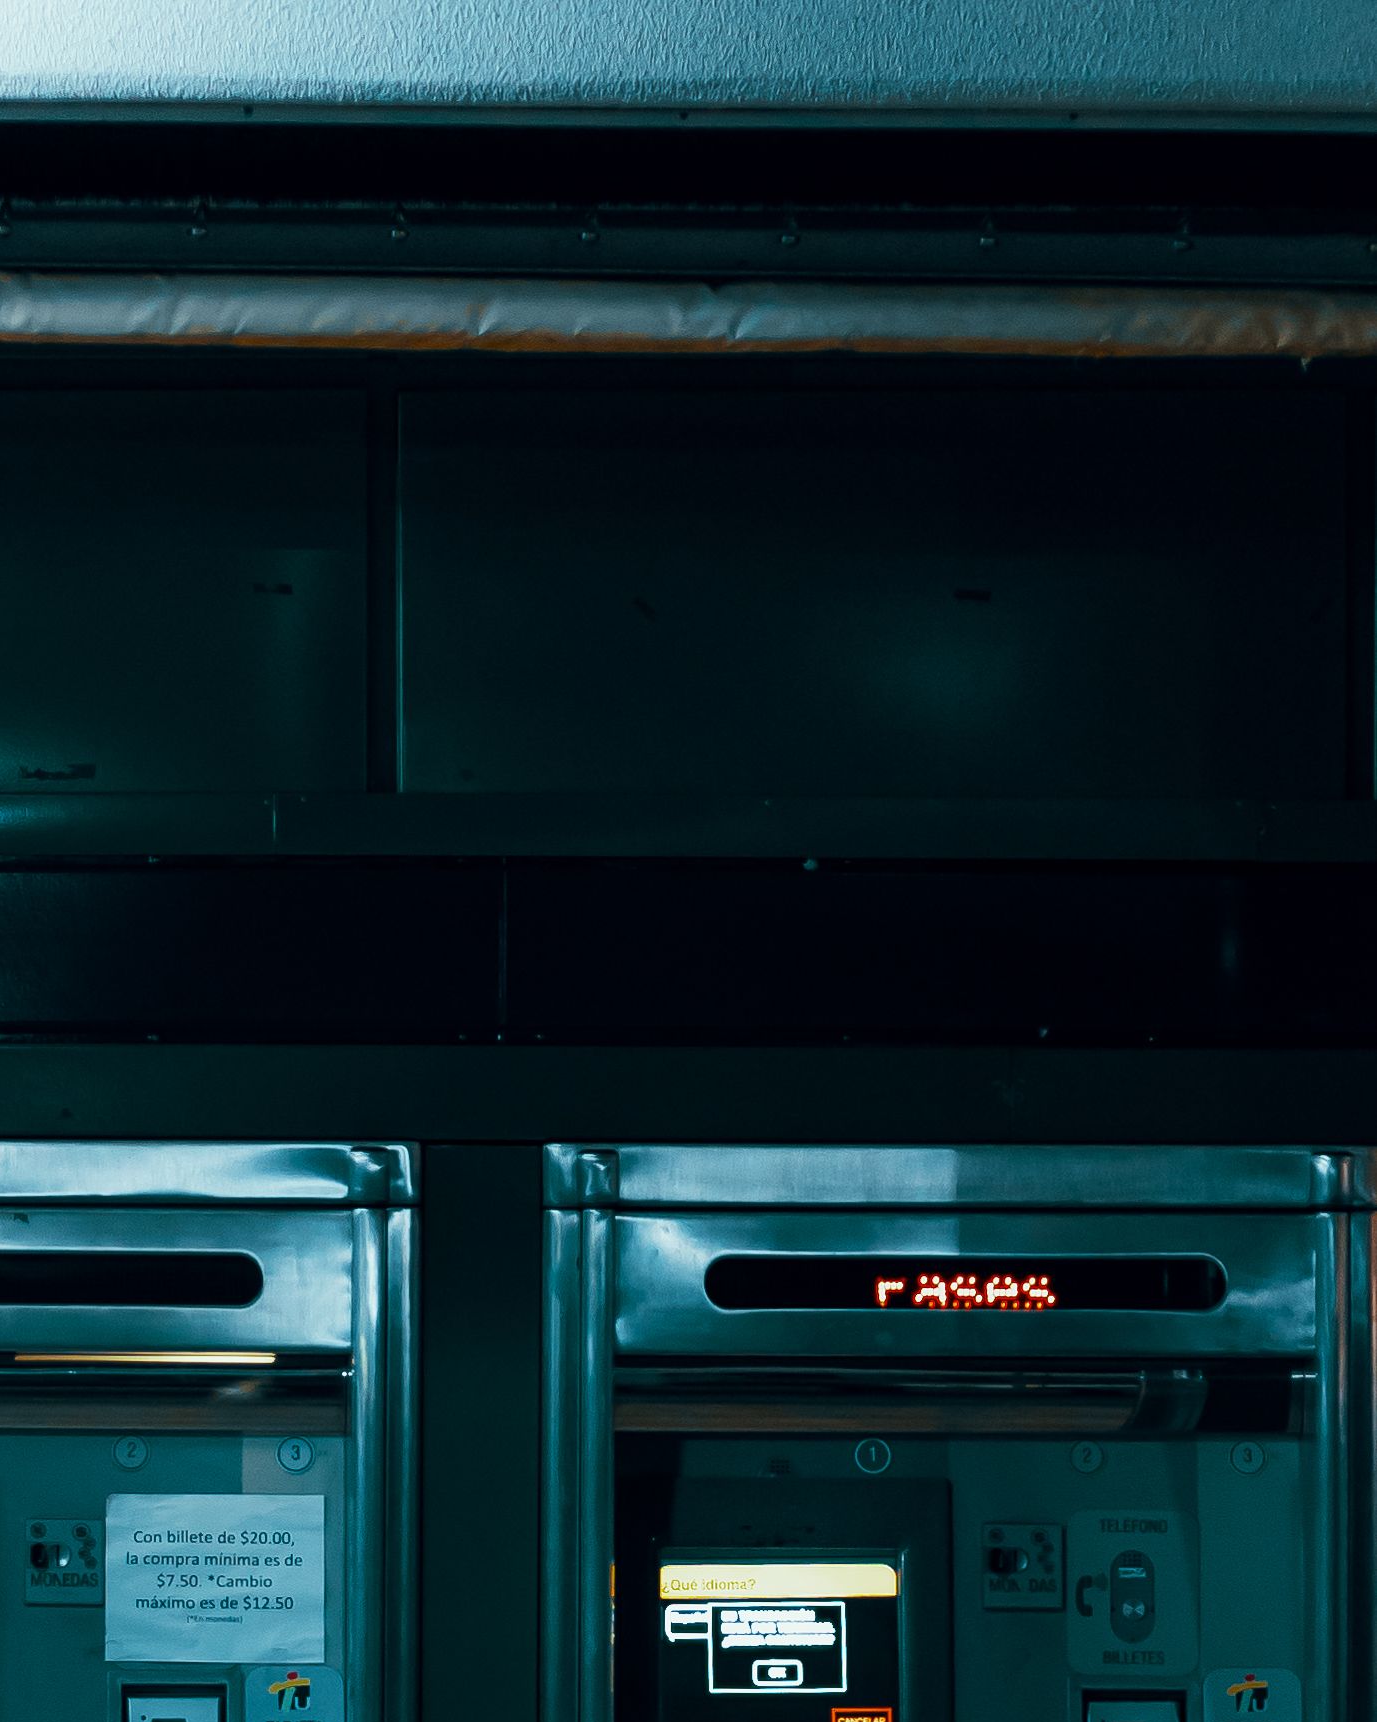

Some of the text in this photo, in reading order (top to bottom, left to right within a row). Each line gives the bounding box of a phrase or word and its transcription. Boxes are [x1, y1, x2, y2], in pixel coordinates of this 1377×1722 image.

[134, 1530, 295, 1548] Con billete de $20.00,
[126, 1552, 303, 1568] la compra mínima es de
[157, 1573, 202, 1589] $7.50.
[135, 1595, 294, 1611] máximo es de $12.50
